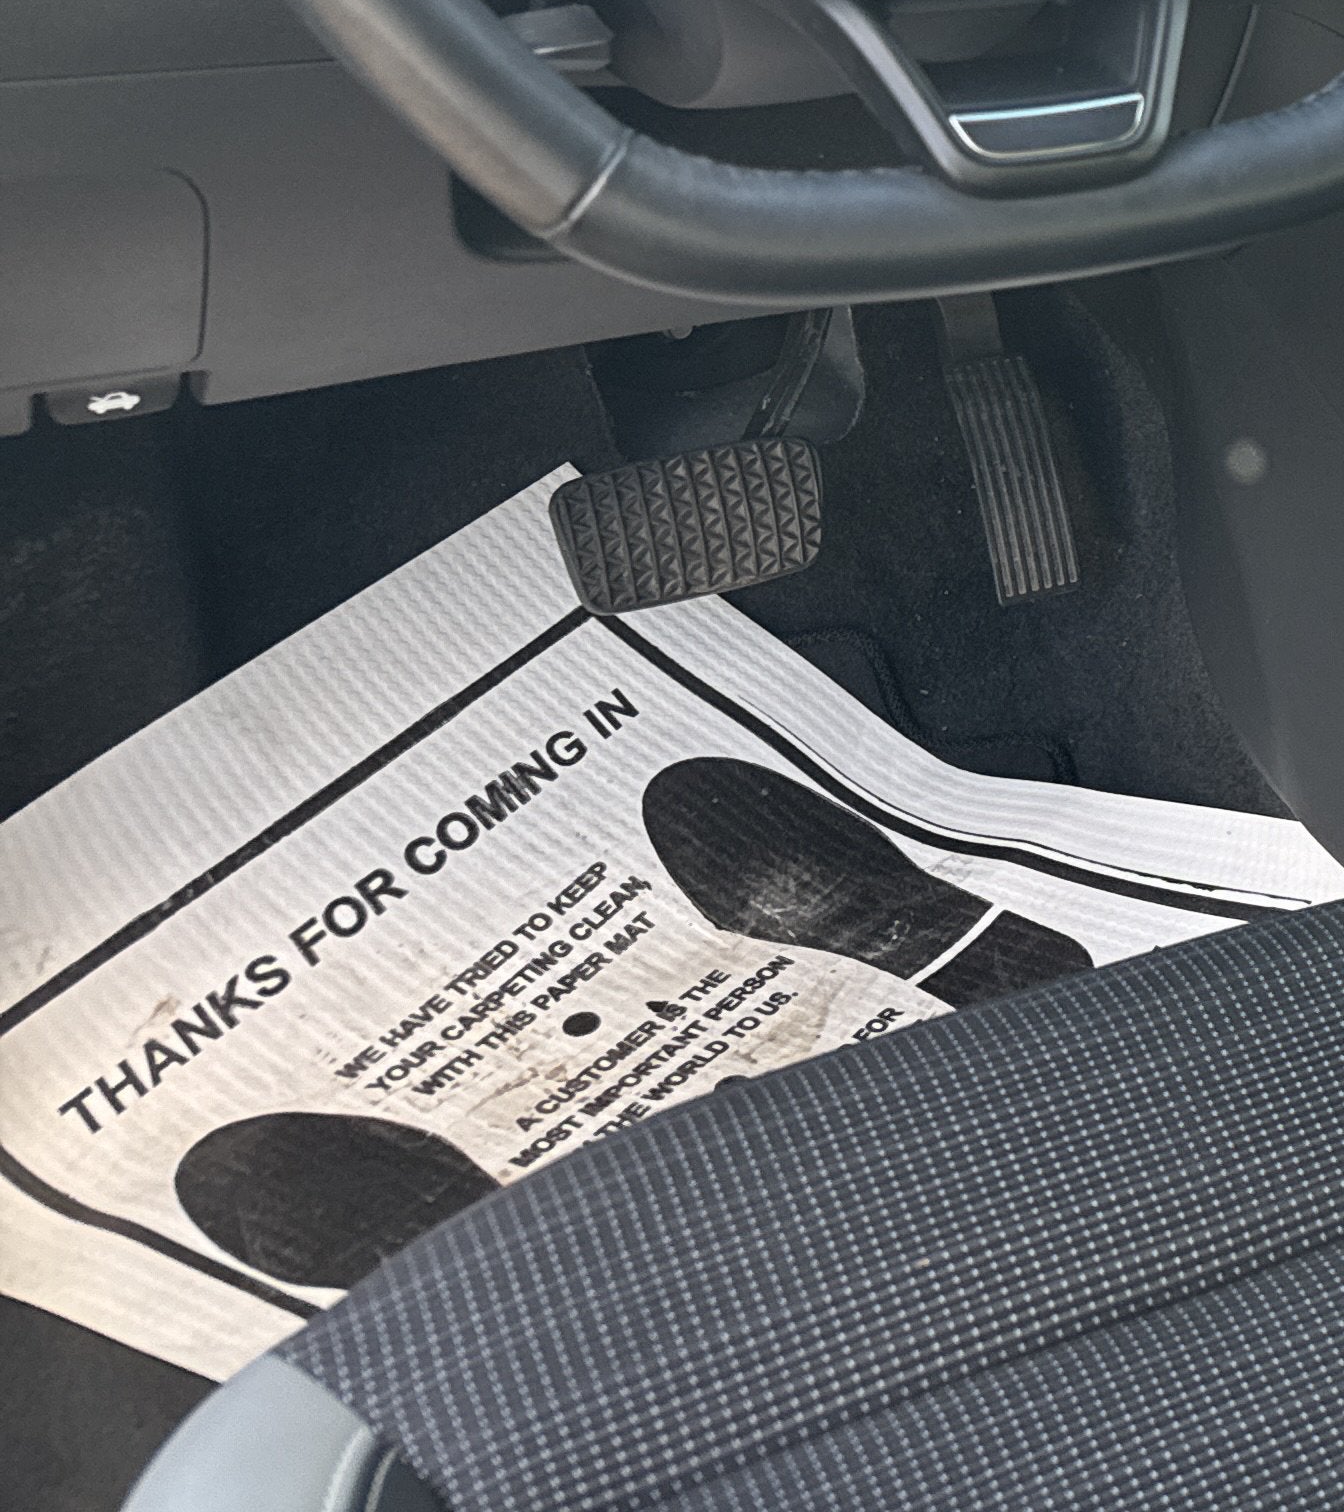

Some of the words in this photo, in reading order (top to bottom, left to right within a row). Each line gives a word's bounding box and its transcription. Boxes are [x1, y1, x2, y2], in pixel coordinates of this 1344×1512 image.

[59, 955, 292, 1134] THANKS
[289, 868, 409, 967] FOR
[403, 730, 588, 876] COMING
[583, 688, 640, 739] IN
[334, 1044, 387, 1079] WE
[379, 993, 453, 1047] HAVE
[444, 939, 519, 995] TRIED
[513, 912, 553, 941] TO
[547, 861, 607, 916] KEEP
[364, 1040, 446, 1091] YOUR
[440, 939, 573, 1041] CARPETING
[568, 875, 653, 941] CLEAN,
[411, 1049, 484, 1095] WITH
[475, 1009, 538, 1050] THIS
[530, 951, 613, 1011] PAPER
[603, 910, 655, 955] MAT
[509, 1114, 584, 1169] MOST
[578, 1019, 704, 1117] IMPORTANT
[702, 954, 796, 1022] PERSON
[516, 1114, 542, 1132] A
[534, 1019, 666, 1116] CUSTOMER
[678, 969, 732, 1002] THE
[640, 1039, 730, 1102] WORLD
[722, 1016, 760, 1040] TO
[754, 989, 800, 1017] US.
[852, 1006, 907, 1042] FOR
